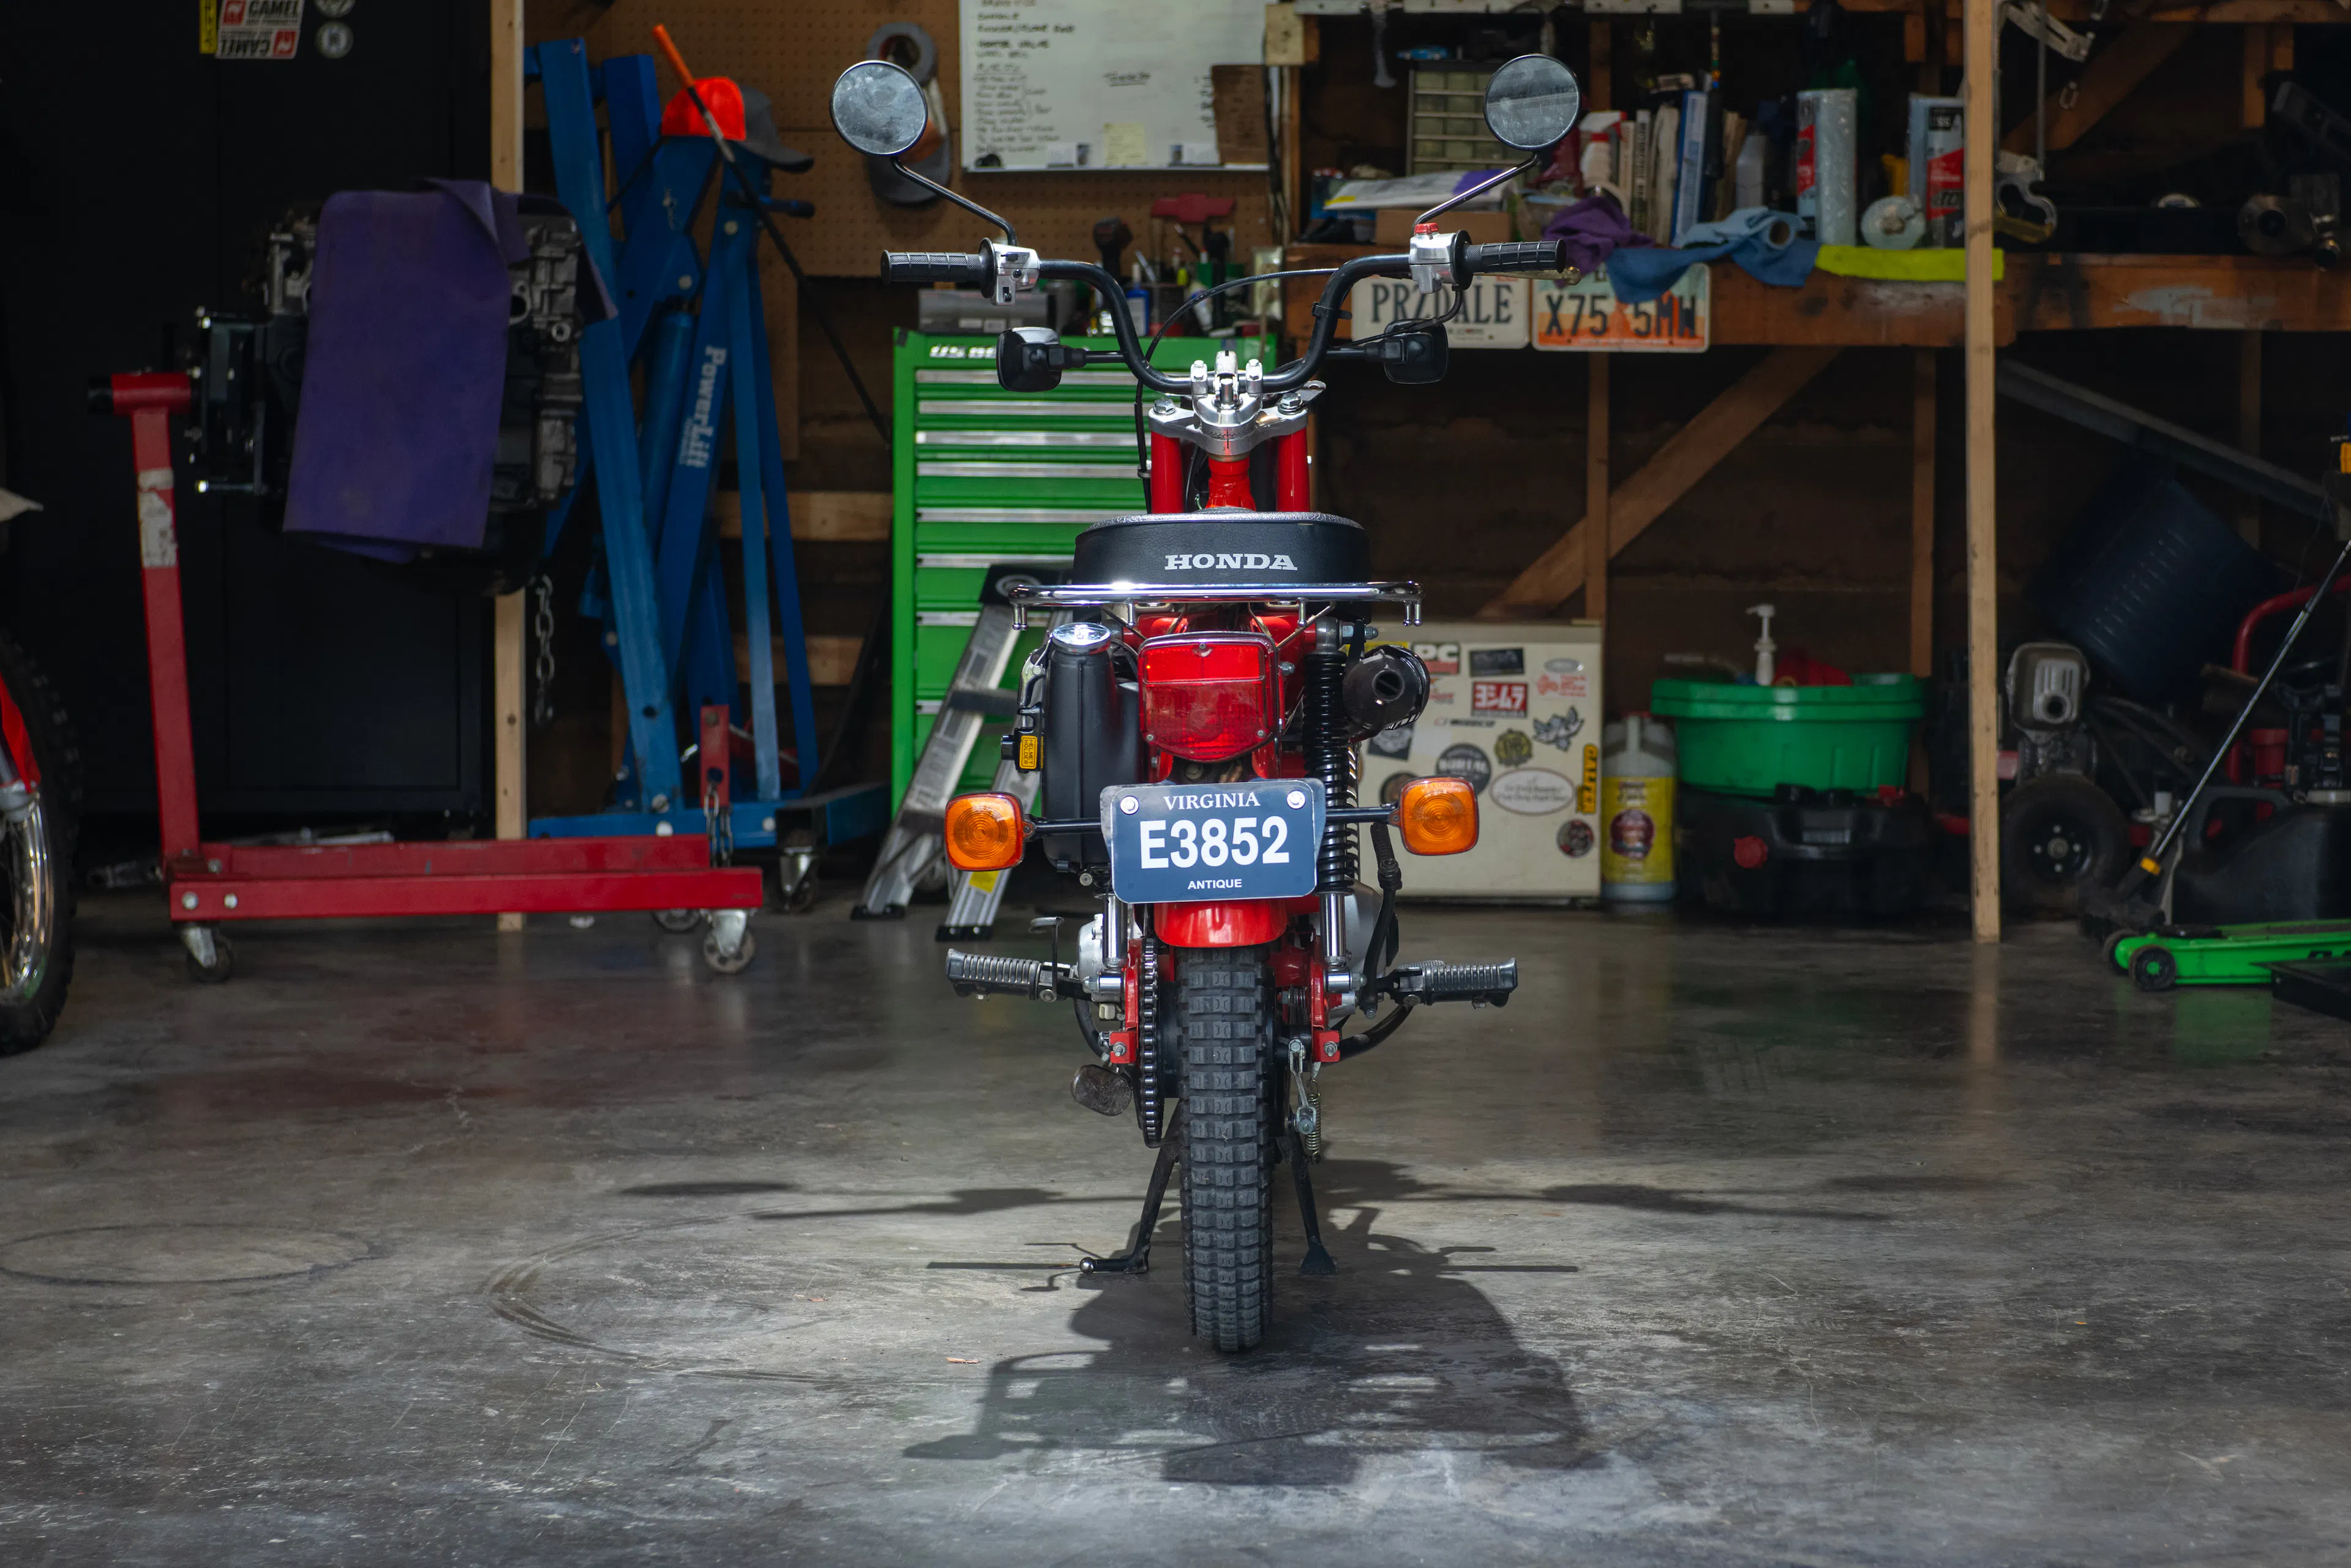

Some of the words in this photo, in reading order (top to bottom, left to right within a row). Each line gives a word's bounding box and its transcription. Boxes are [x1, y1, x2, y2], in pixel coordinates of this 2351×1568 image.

[1545, 294, 1608, 337] X75
[1164, 553, 1298, 571] HONDA
[1163, 792, 1261, 811] VIRGINIA
[1140, 816, 1290, 869] E3852
[1187, 879, 1242, 890] ANTIQUE
